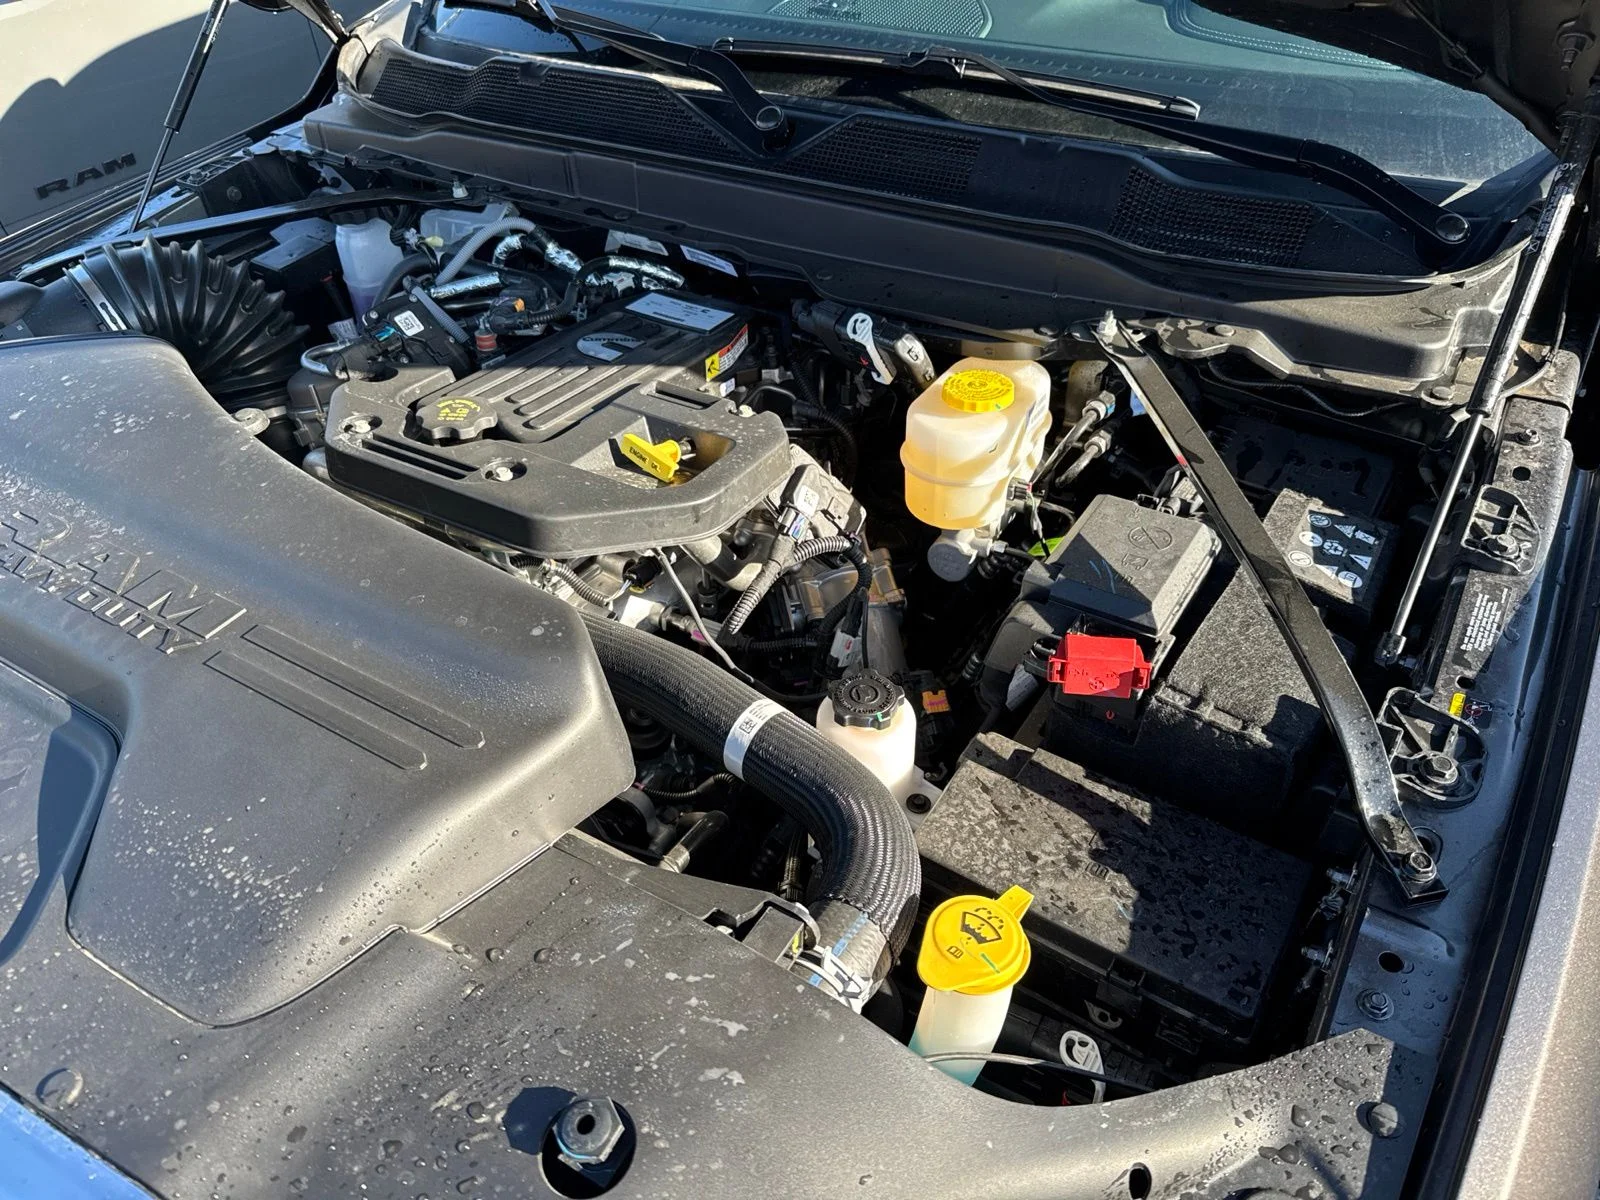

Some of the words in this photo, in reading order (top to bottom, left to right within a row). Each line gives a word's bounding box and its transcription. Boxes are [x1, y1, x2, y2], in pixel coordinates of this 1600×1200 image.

[35, 152, 137, 200] RAM
[629, 446, 649, 464] ENGINE
[0, 501, 247, 640] RAM
[63, 584, 203, 655] DUTY
